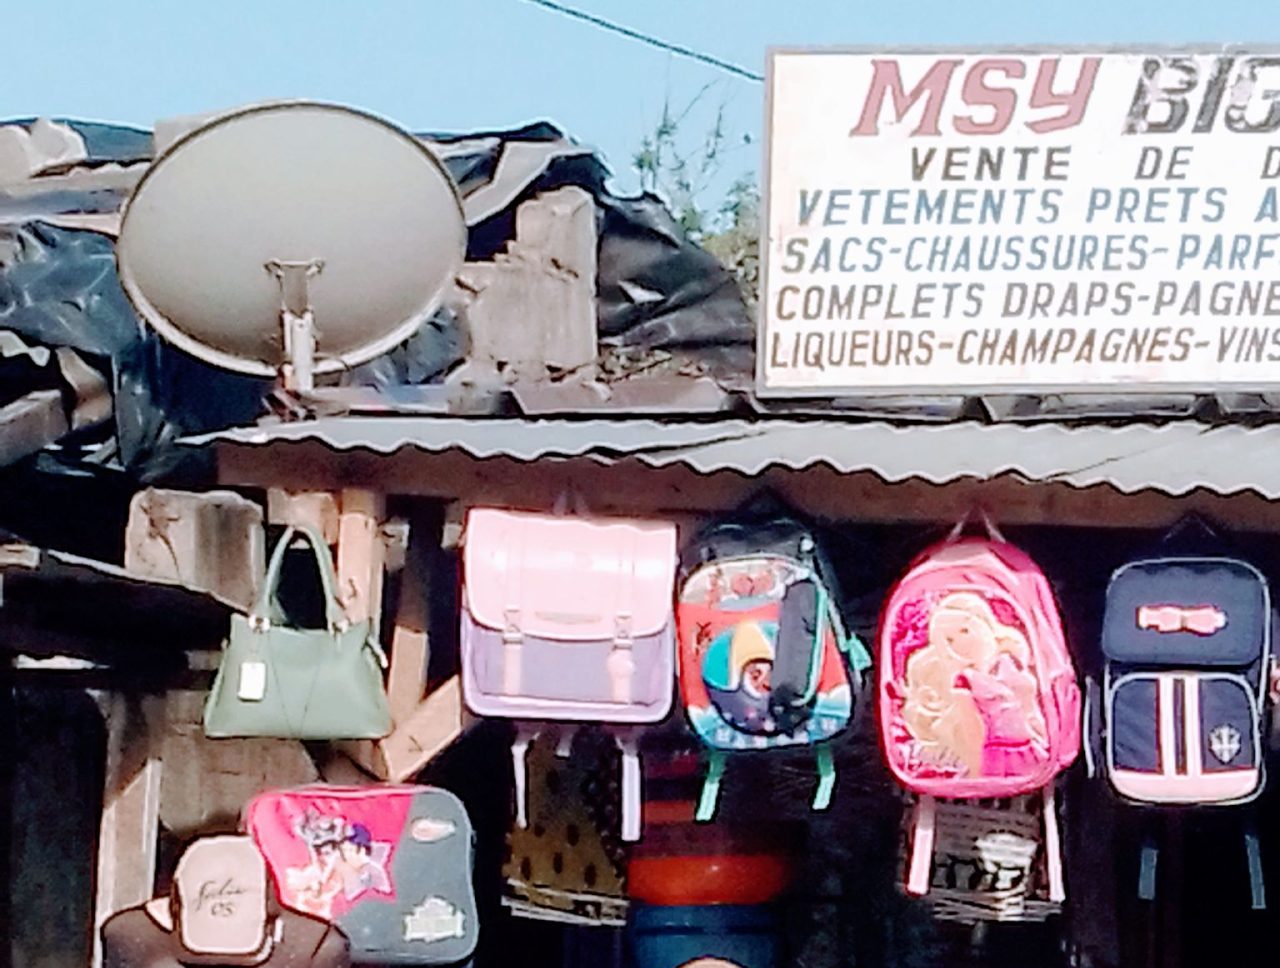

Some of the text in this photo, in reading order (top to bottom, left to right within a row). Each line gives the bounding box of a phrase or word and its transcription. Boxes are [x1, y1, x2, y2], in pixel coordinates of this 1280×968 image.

[911, 145, 1072, 181] VENTE
[1134, 145, 1194, 181] DE
[798, 188, 1062, 226] VETEMENTS
[1085, 187, 1228, 224] PRETS
[1253, 187, 1279, 223] A
[775, 282, 985, 321] COMPLETS
